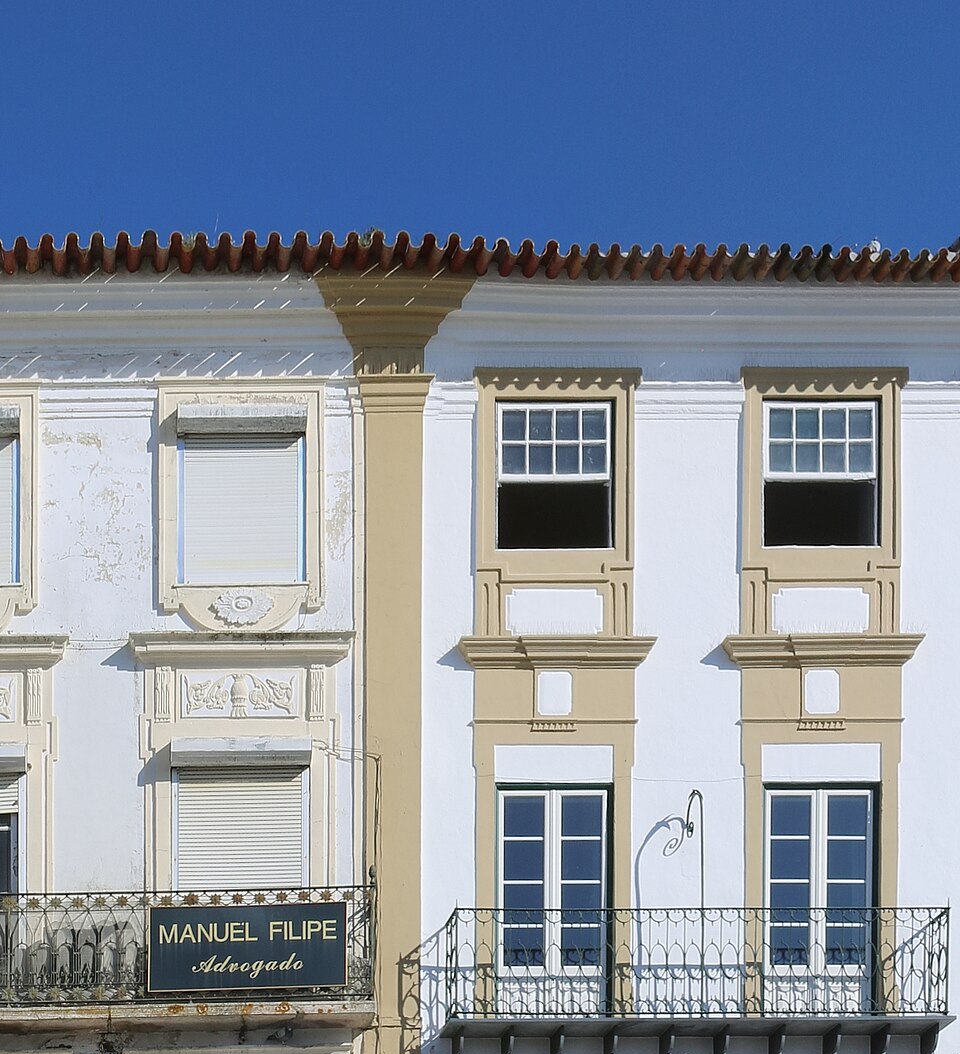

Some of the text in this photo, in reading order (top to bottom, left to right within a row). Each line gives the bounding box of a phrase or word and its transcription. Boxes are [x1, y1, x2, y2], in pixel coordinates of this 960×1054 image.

[159, 919, 337, 944] MANUEL FILIPE
[192, 952, 304, 979] Advogado
